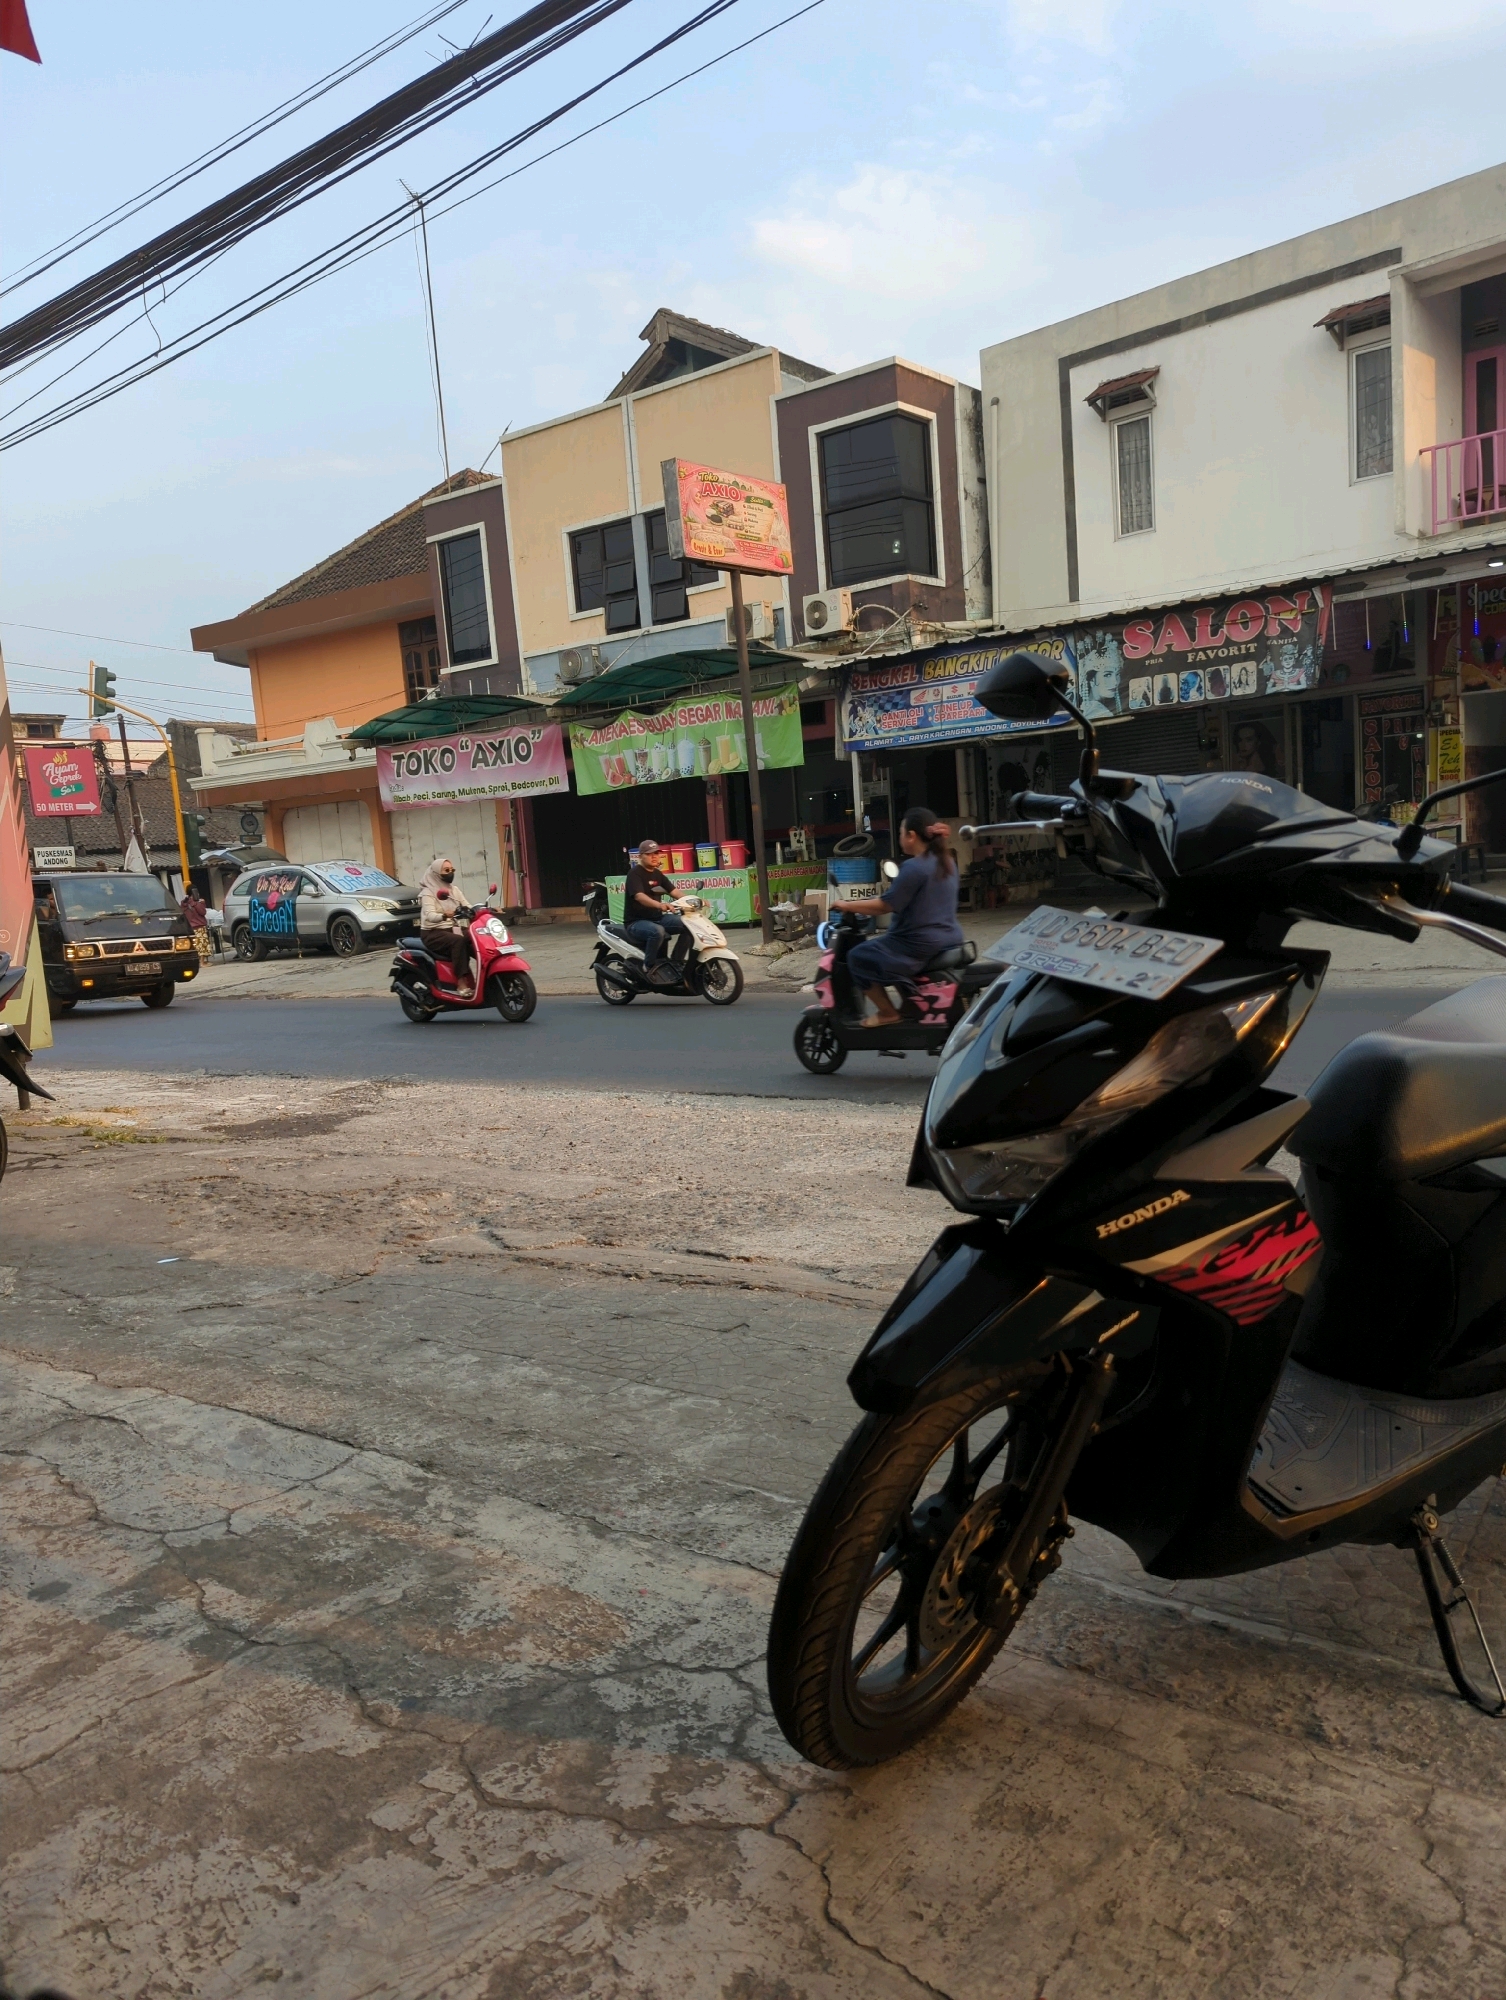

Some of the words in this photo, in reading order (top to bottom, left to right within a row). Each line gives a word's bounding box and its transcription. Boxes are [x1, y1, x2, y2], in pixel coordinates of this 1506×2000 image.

[699, 472, 719, 481] Toko
[702, 482, 740, 500] AXIO
[1122, 591, 1312, 659] SALON
[1186, 643, 1258, 663] FAVORIT
[1145, 657, 1164, 666] PRIA
[851, 663, 918, 692] BENGKEL
[923, 649, 999, 681] BANGKIT
[881, 709, 908, 722] GANTI
[909, 706, 924, 718] OLI
[933, 701, 958, 713] TUNE
[960, 699, 974, 711] UP
[587, 721, 630, 746] ANEKA
[629, 716, 645, 736] ES
[677, 701, 722, 727] SEGAR
[724, 696, 777, 720] MAANI
[881, 717, 917, 730] SERVICE
[933, 707, 987, 724] SPAREPART
[1384, 716, 1424, 734] PRIA
[864, 738, 893, 747] ALAMAT
[909, 733, 930, 741] RAYA
[1440, 738, 1458, 750] Es
[391, 745, 456, 780] TOKO
[1364, 719, 1382, 803] SALON
[1439, 753, 1460, 765] Teh
[43, 762, 78, 777] Ayam
[50, 771, 82, 785] Geprek
[1220, 778, 1273, 794] HONDA
[431, 788, 457, 800] Sarung,
[458, 786, 488, 798] Mukena,
[488, 783, 510, 796] Sprei,
[511, 779, 548, 792] Bedcover,
[36, 803, 46, 811] 50
[48, 803, 74, 811] METER
[37, 849, 73, 858] PUSKESMAS
[43, 858, 68, 866] ANDONG
[774, 869, 781, 879] ES
[781, 868, 793, 879] BUAH
[794, 866, 808, 877] SEGAR
[256, 874, 268, 893] On
[268, 873, 279, 891] The
[251, 898, 294, 933] GACOAN
[1020, 913, 1068, 938] AD
[1060, 920, 1140, 954] 6604
[1128, 933, 1205, 966] BED
[1095, 1189, 1192, 1239] HONDA
